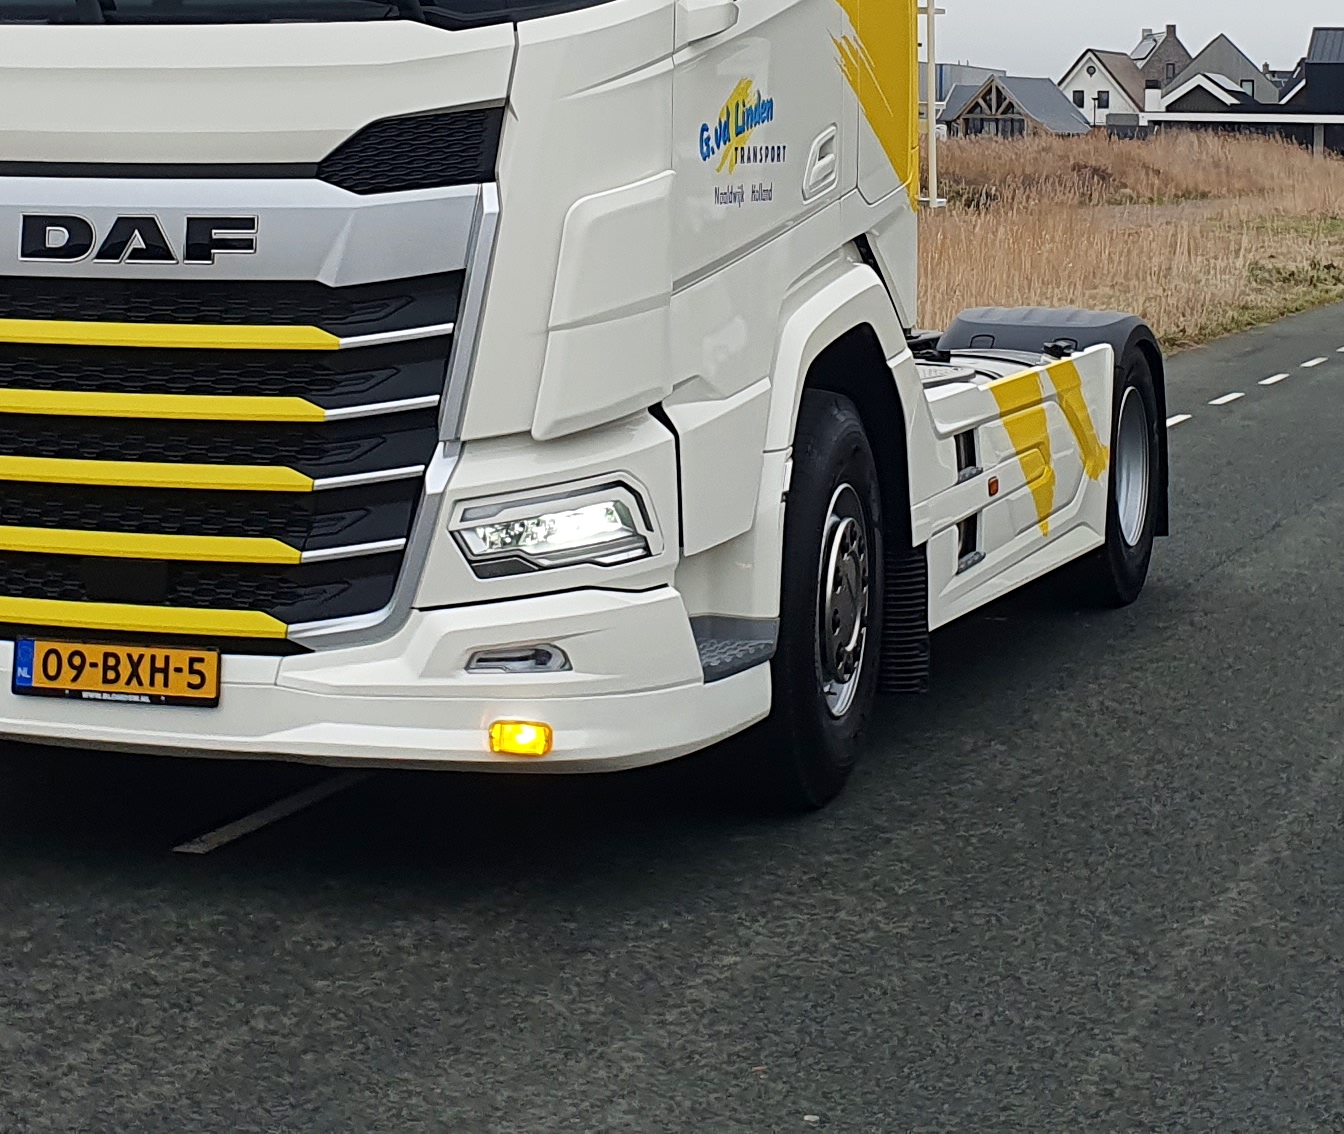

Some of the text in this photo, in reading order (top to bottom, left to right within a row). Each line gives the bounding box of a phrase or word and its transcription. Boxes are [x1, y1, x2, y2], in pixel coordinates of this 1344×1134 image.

[699, 88, 774, 161] G. vd Linden
[734, 145, 786, 164] TRANSPORT
[751, 182, 773, 202] Holland
[18, 212, 259, 265] DAF
[16, 667, 31, 679] NL
[41, 648, 207, 690] 09-BXH-5
